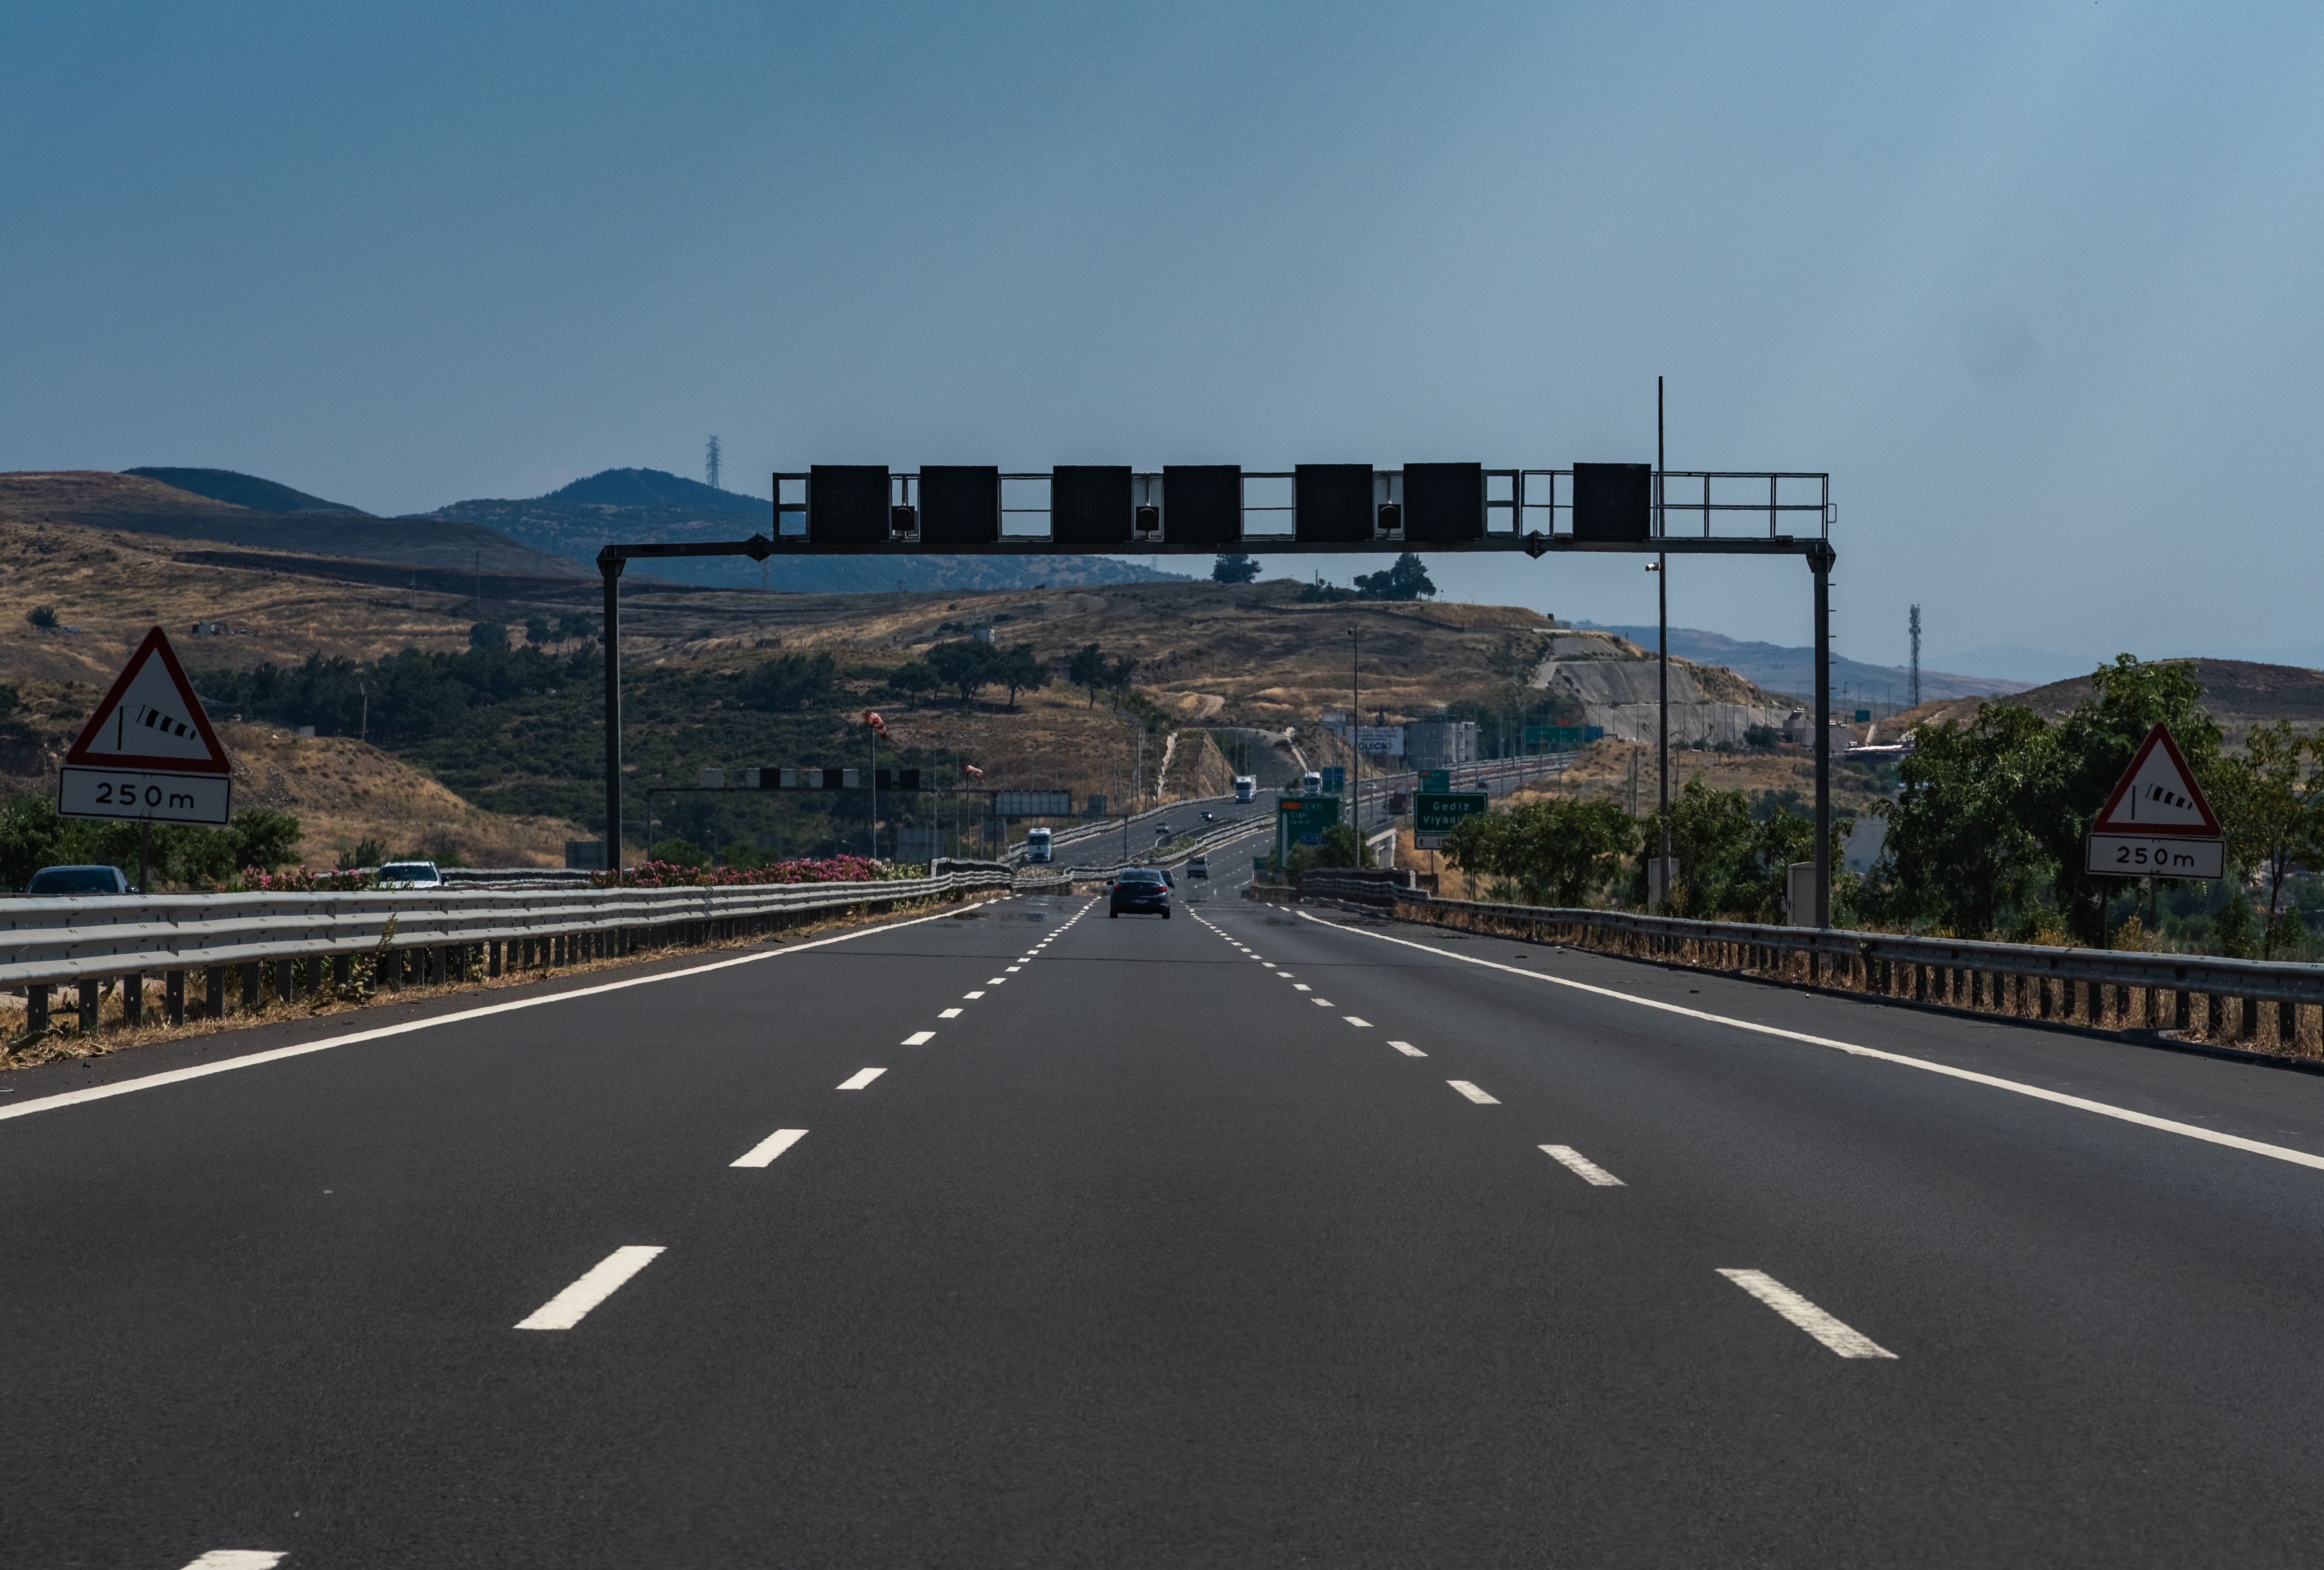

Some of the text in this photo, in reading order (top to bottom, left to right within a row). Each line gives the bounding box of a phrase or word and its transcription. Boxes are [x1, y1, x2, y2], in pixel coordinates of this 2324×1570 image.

[96, 783, 194, 809] 250m
[1433, 802, 1470, 811] Gediz
[2116, 846, 2194, 867] 250m
